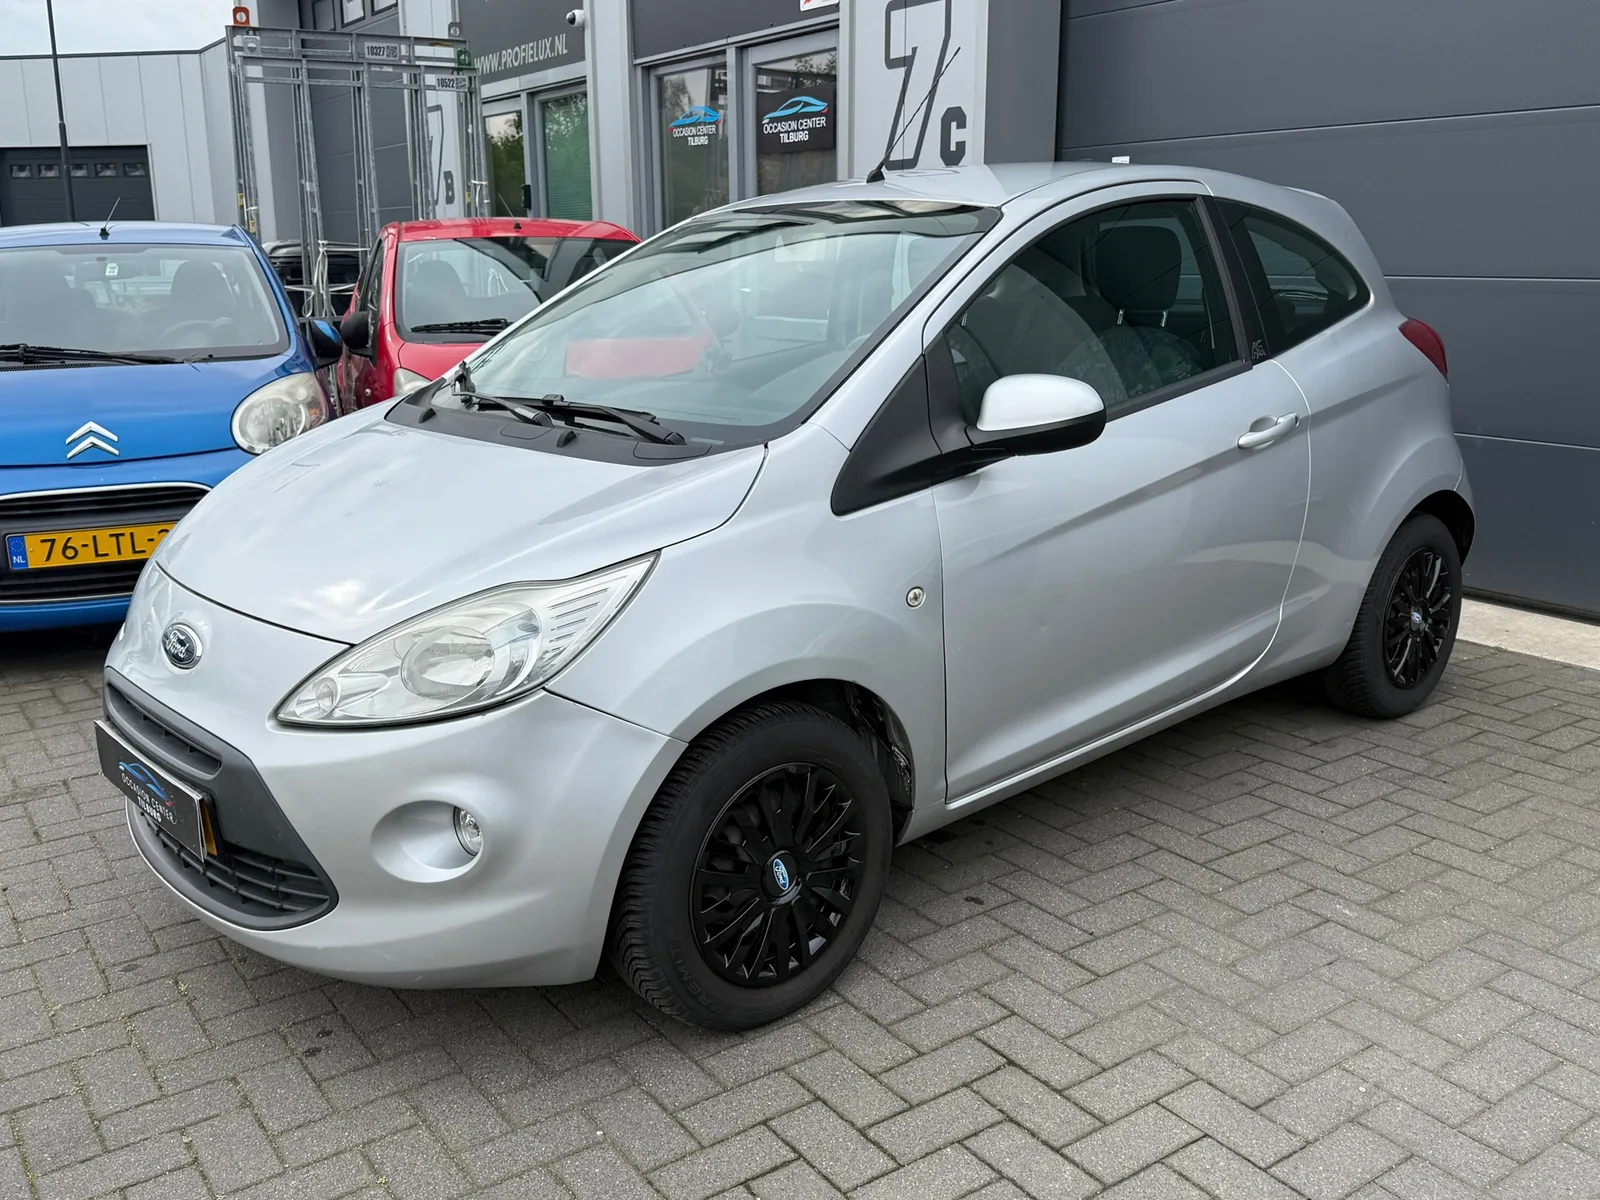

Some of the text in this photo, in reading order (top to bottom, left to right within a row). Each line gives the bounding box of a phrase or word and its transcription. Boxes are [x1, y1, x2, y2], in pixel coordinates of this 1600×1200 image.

[474, 33, 568, 75] WWW.PROFIELUX.NL
[884, 0, 952, 171] 7
[672, 125, 716, 137] OCCASION CENTER
[763, 117, 826, 134] OCCASION CENTER
[687, 136, 709, 146] TILBURG
[779, 131, 809, 144] TILBURG
[12, 555, 26, 565] NL
[166, 630, 190, 658] Ford
[121, 772, 174, 823] OCCASION CENTER
[136, 795, 162, 822] TILBURG
